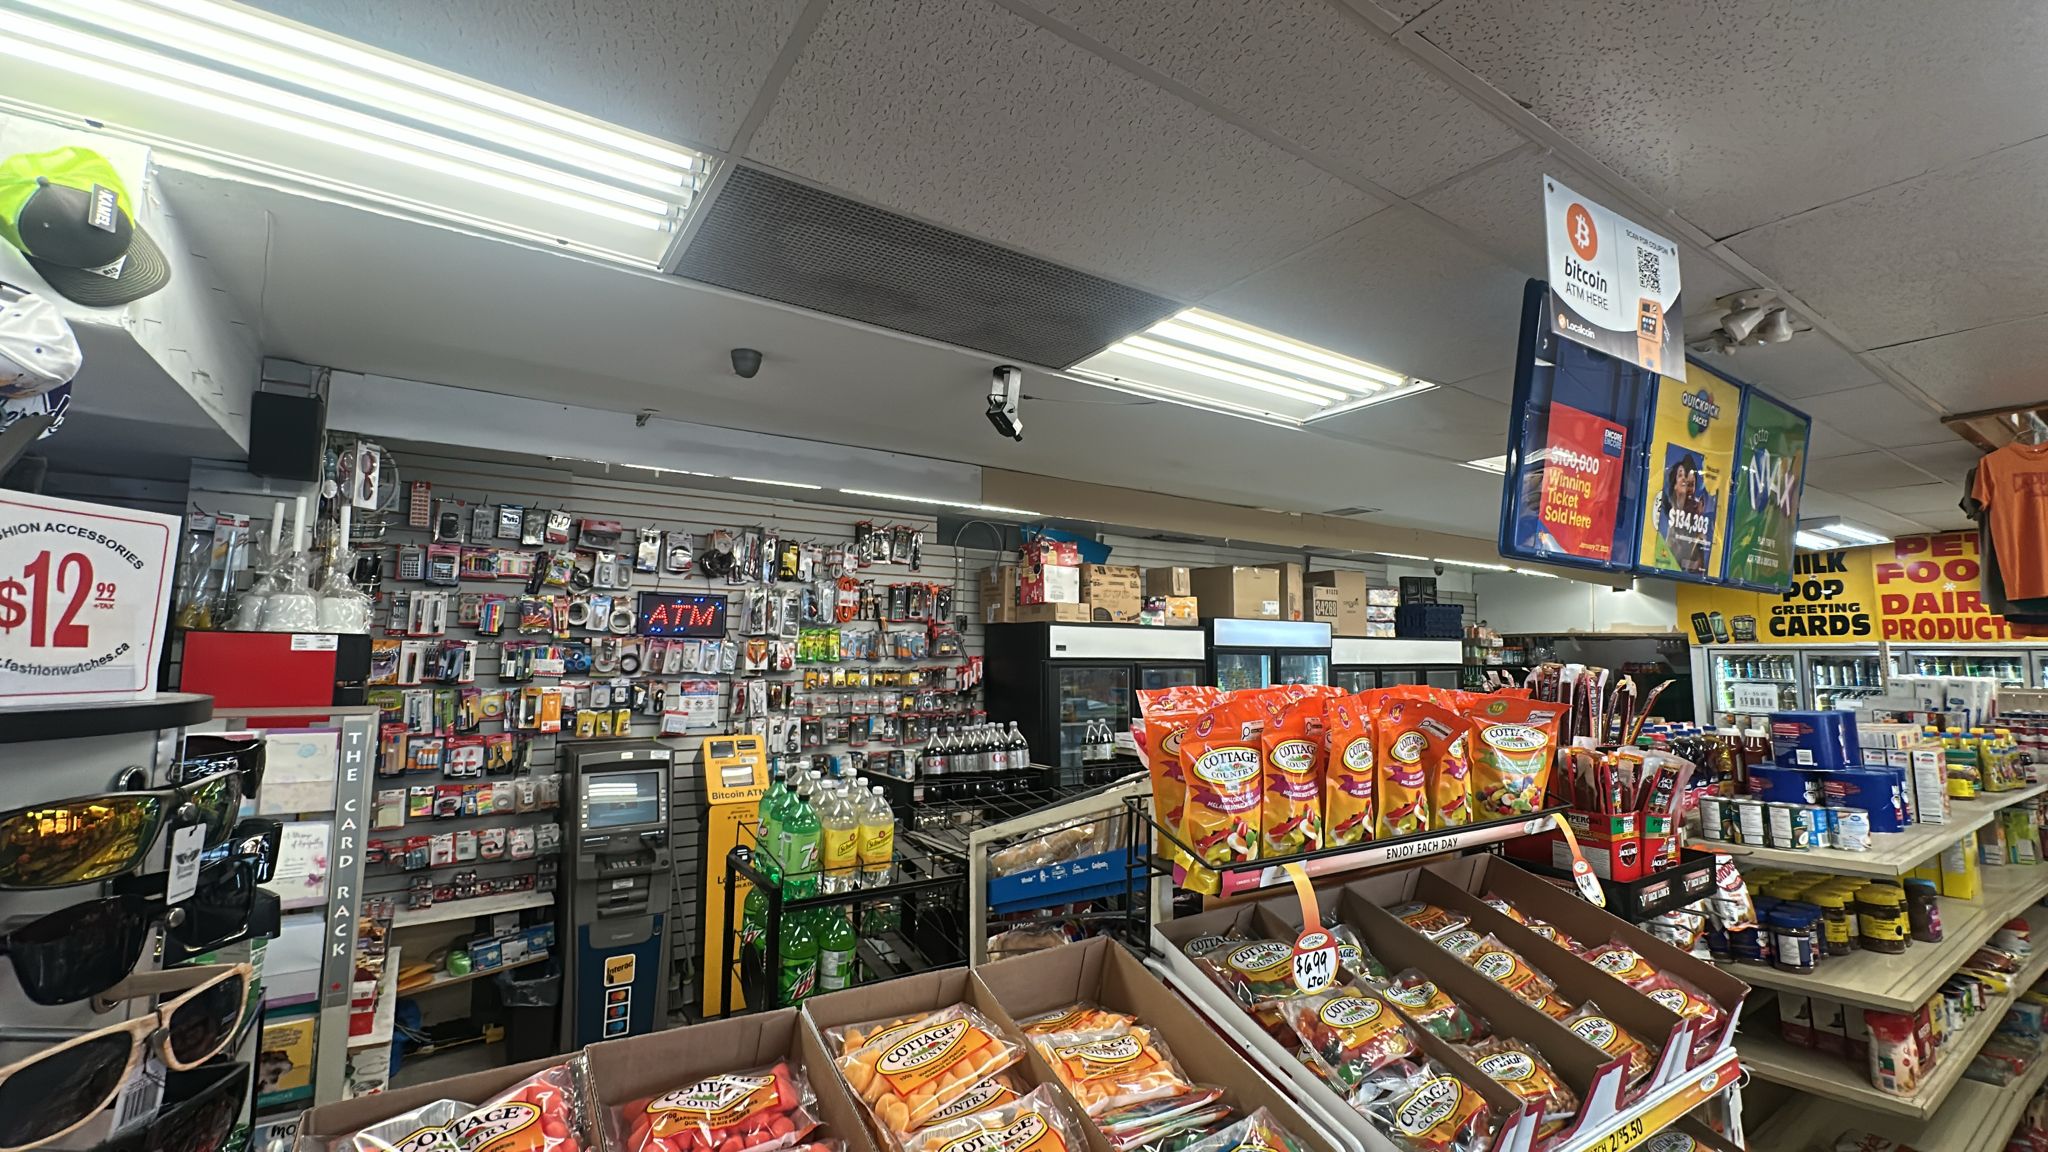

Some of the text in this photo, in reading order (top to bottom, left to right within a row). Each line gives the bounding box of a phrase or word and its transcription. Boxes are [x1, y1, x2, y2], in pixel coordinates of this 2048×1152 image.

[1565, 256, 1607, 293] bitcoin
[1566, 282, 1609, 311] ATM HERE
[1566, 318, 1595, 339] Localcoin
[1682, 392, 1721, 420] QUICKPICK
[1692, 414, 1708, 428] PACKS
[1549, 468, 1591, 499] Winning
[1749, 448, 1796, 518] MAX
[1548, 487, 1579, 509] Ticket
[1544, 505, 1592, 529] Sold Here
[1668, 508, 1709, 535] $134,303
[44, 523, 144, 570] ACCESSORIES
[1783, 579, 1844, 602] POP
[648, 604, 716, 626] ATM
[1771, 602, 1861, 615] GREETING
[1769, 613, 1871, 637] CARDS
[346, 732, 362, 782] THE
[1203, 751, 1258, 770] COTTAGE
[1211, 765, 1255, 780] COUNTRY
[711, 789, 745, 800] Bitcoin
[339, 799, 356, 869] CARD
[1386, 837, 1458, 860] ENJOY EACH DAY
[332, 886, 350, 957] RACK
[1234, 943, 1285, 963] COTTAGE
[887, 1024, 956, 1064] COTTAGE
[902, 1034, 955, 1067] COUNTRY
[1400, 1079, 1450, 1127] COTTAGE
[1417, 1096, 1455, 1130] COUNTRY
